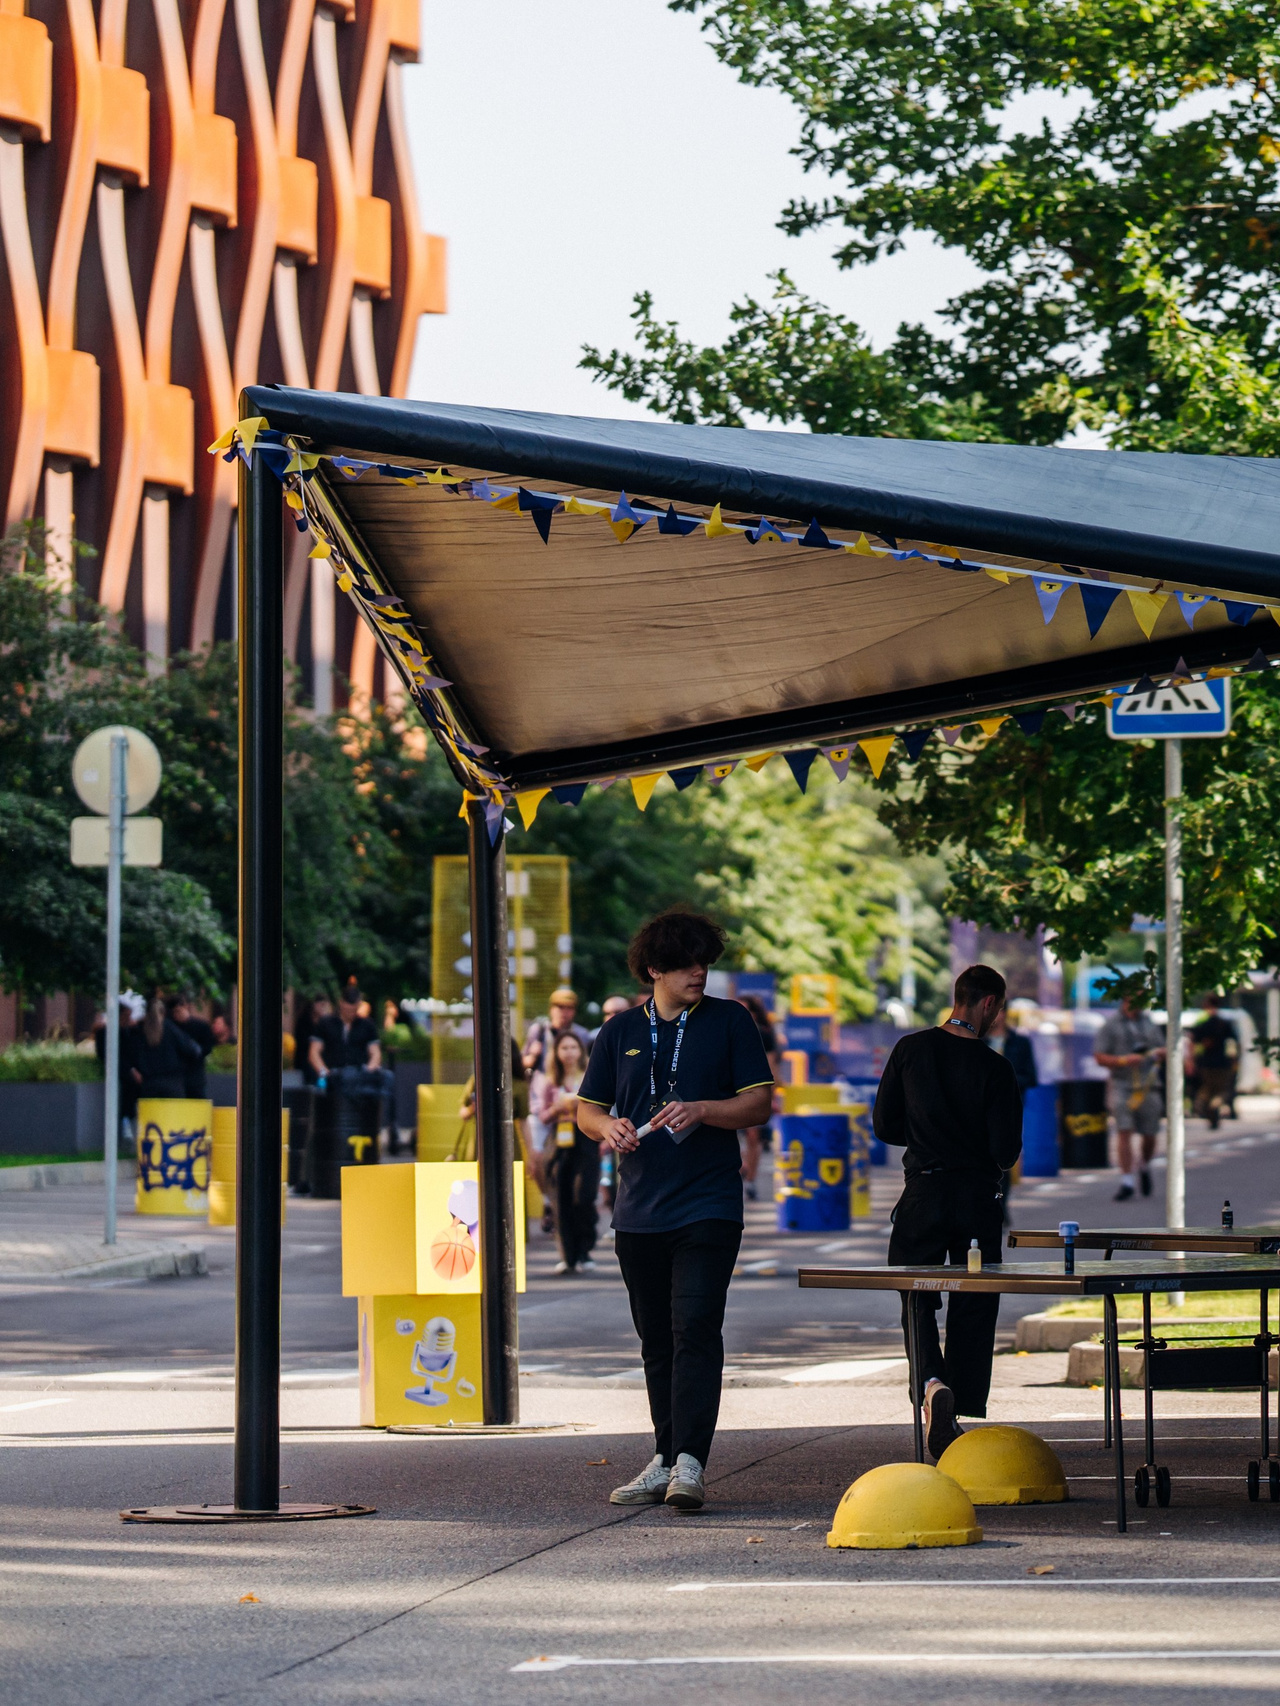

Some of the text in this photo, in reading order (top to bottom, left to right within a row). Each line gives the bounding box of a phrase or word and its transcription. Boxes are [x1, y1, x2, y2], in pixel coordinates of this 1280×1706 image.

[1110, 1239, 1155, 1250] START LINE
[912, 1279, 963, 1290] START LINE
[1134, 1279, 1182, 1290] GAME INDOOR
